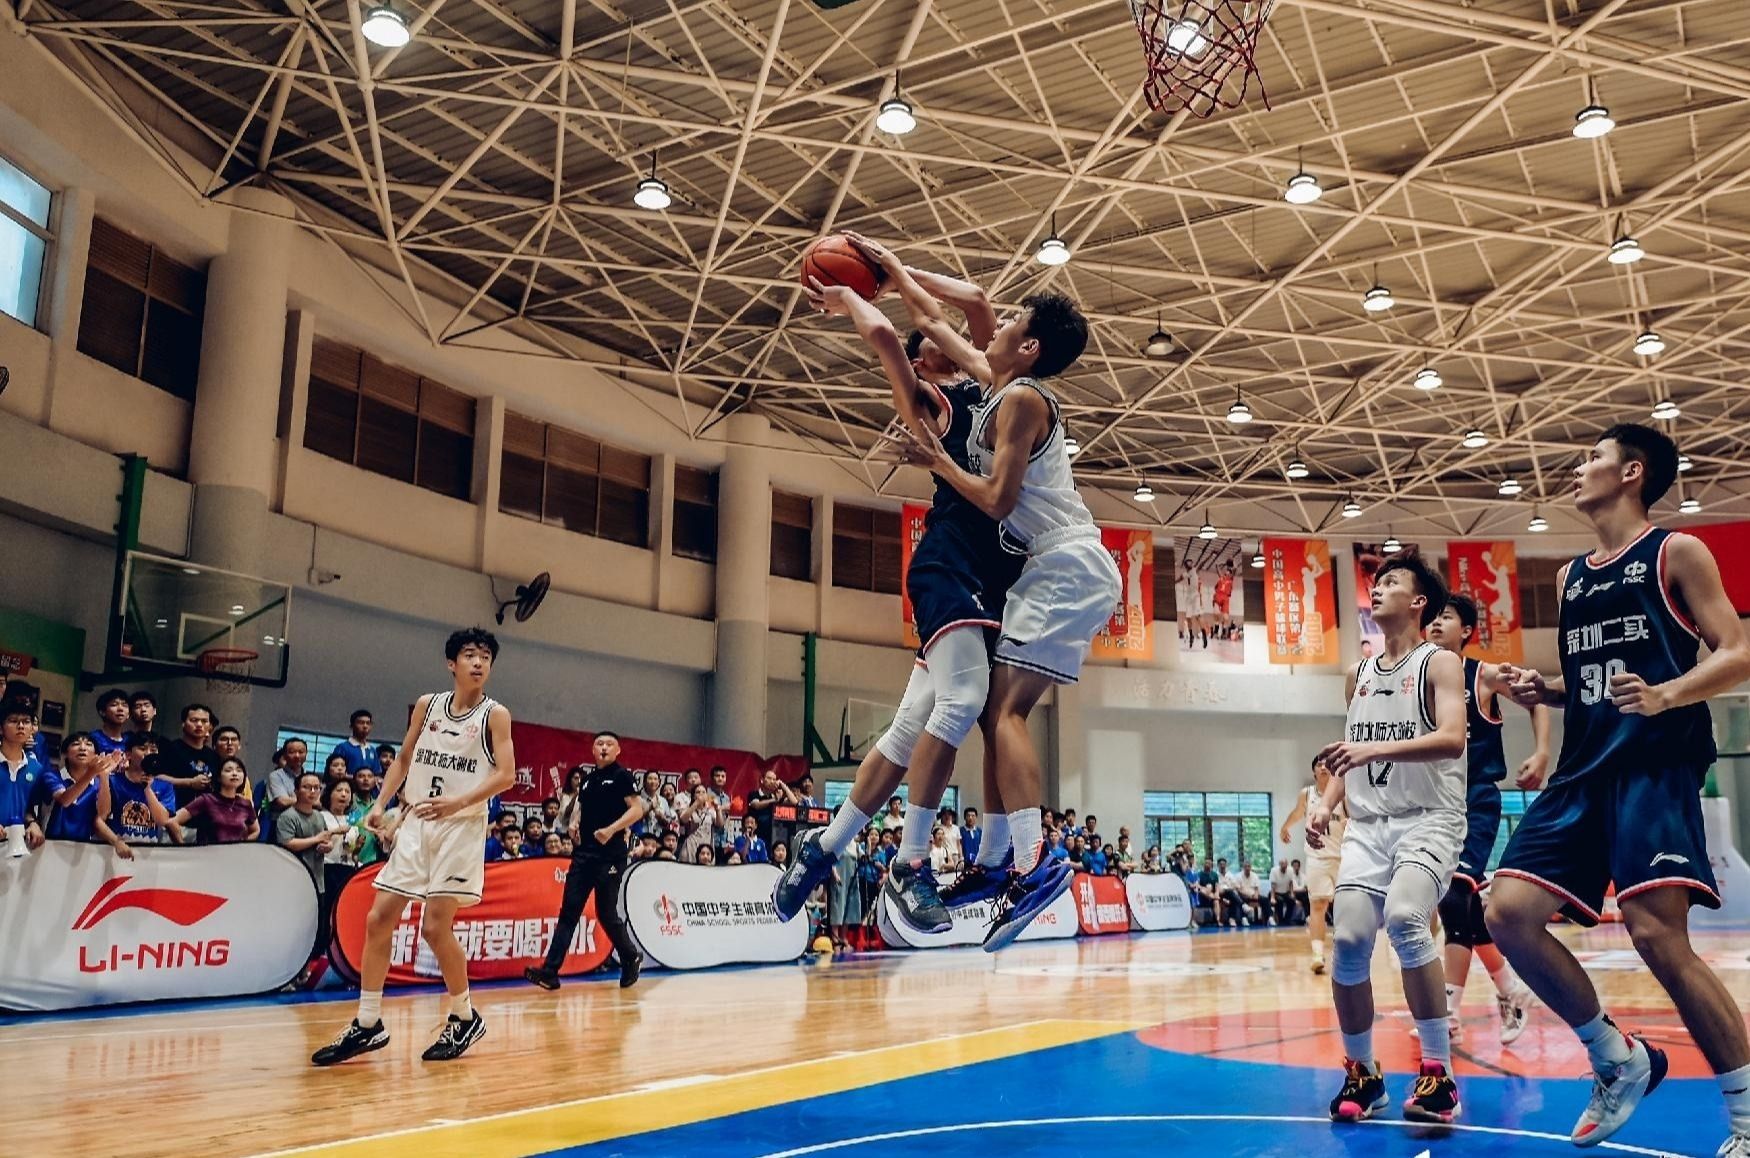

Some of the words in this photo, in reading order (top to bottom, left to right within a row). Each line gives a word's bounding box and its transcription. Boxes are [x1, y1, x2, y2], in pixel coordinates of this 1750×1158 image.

[1580, 658, 1626, 706] 30
[428, 775, 445, 798] 5
[707, 918, 731, 926] SCHOOL
[733, 917, 755, 926] SPORTS
[79, 940, 230, 973] LI-NING
